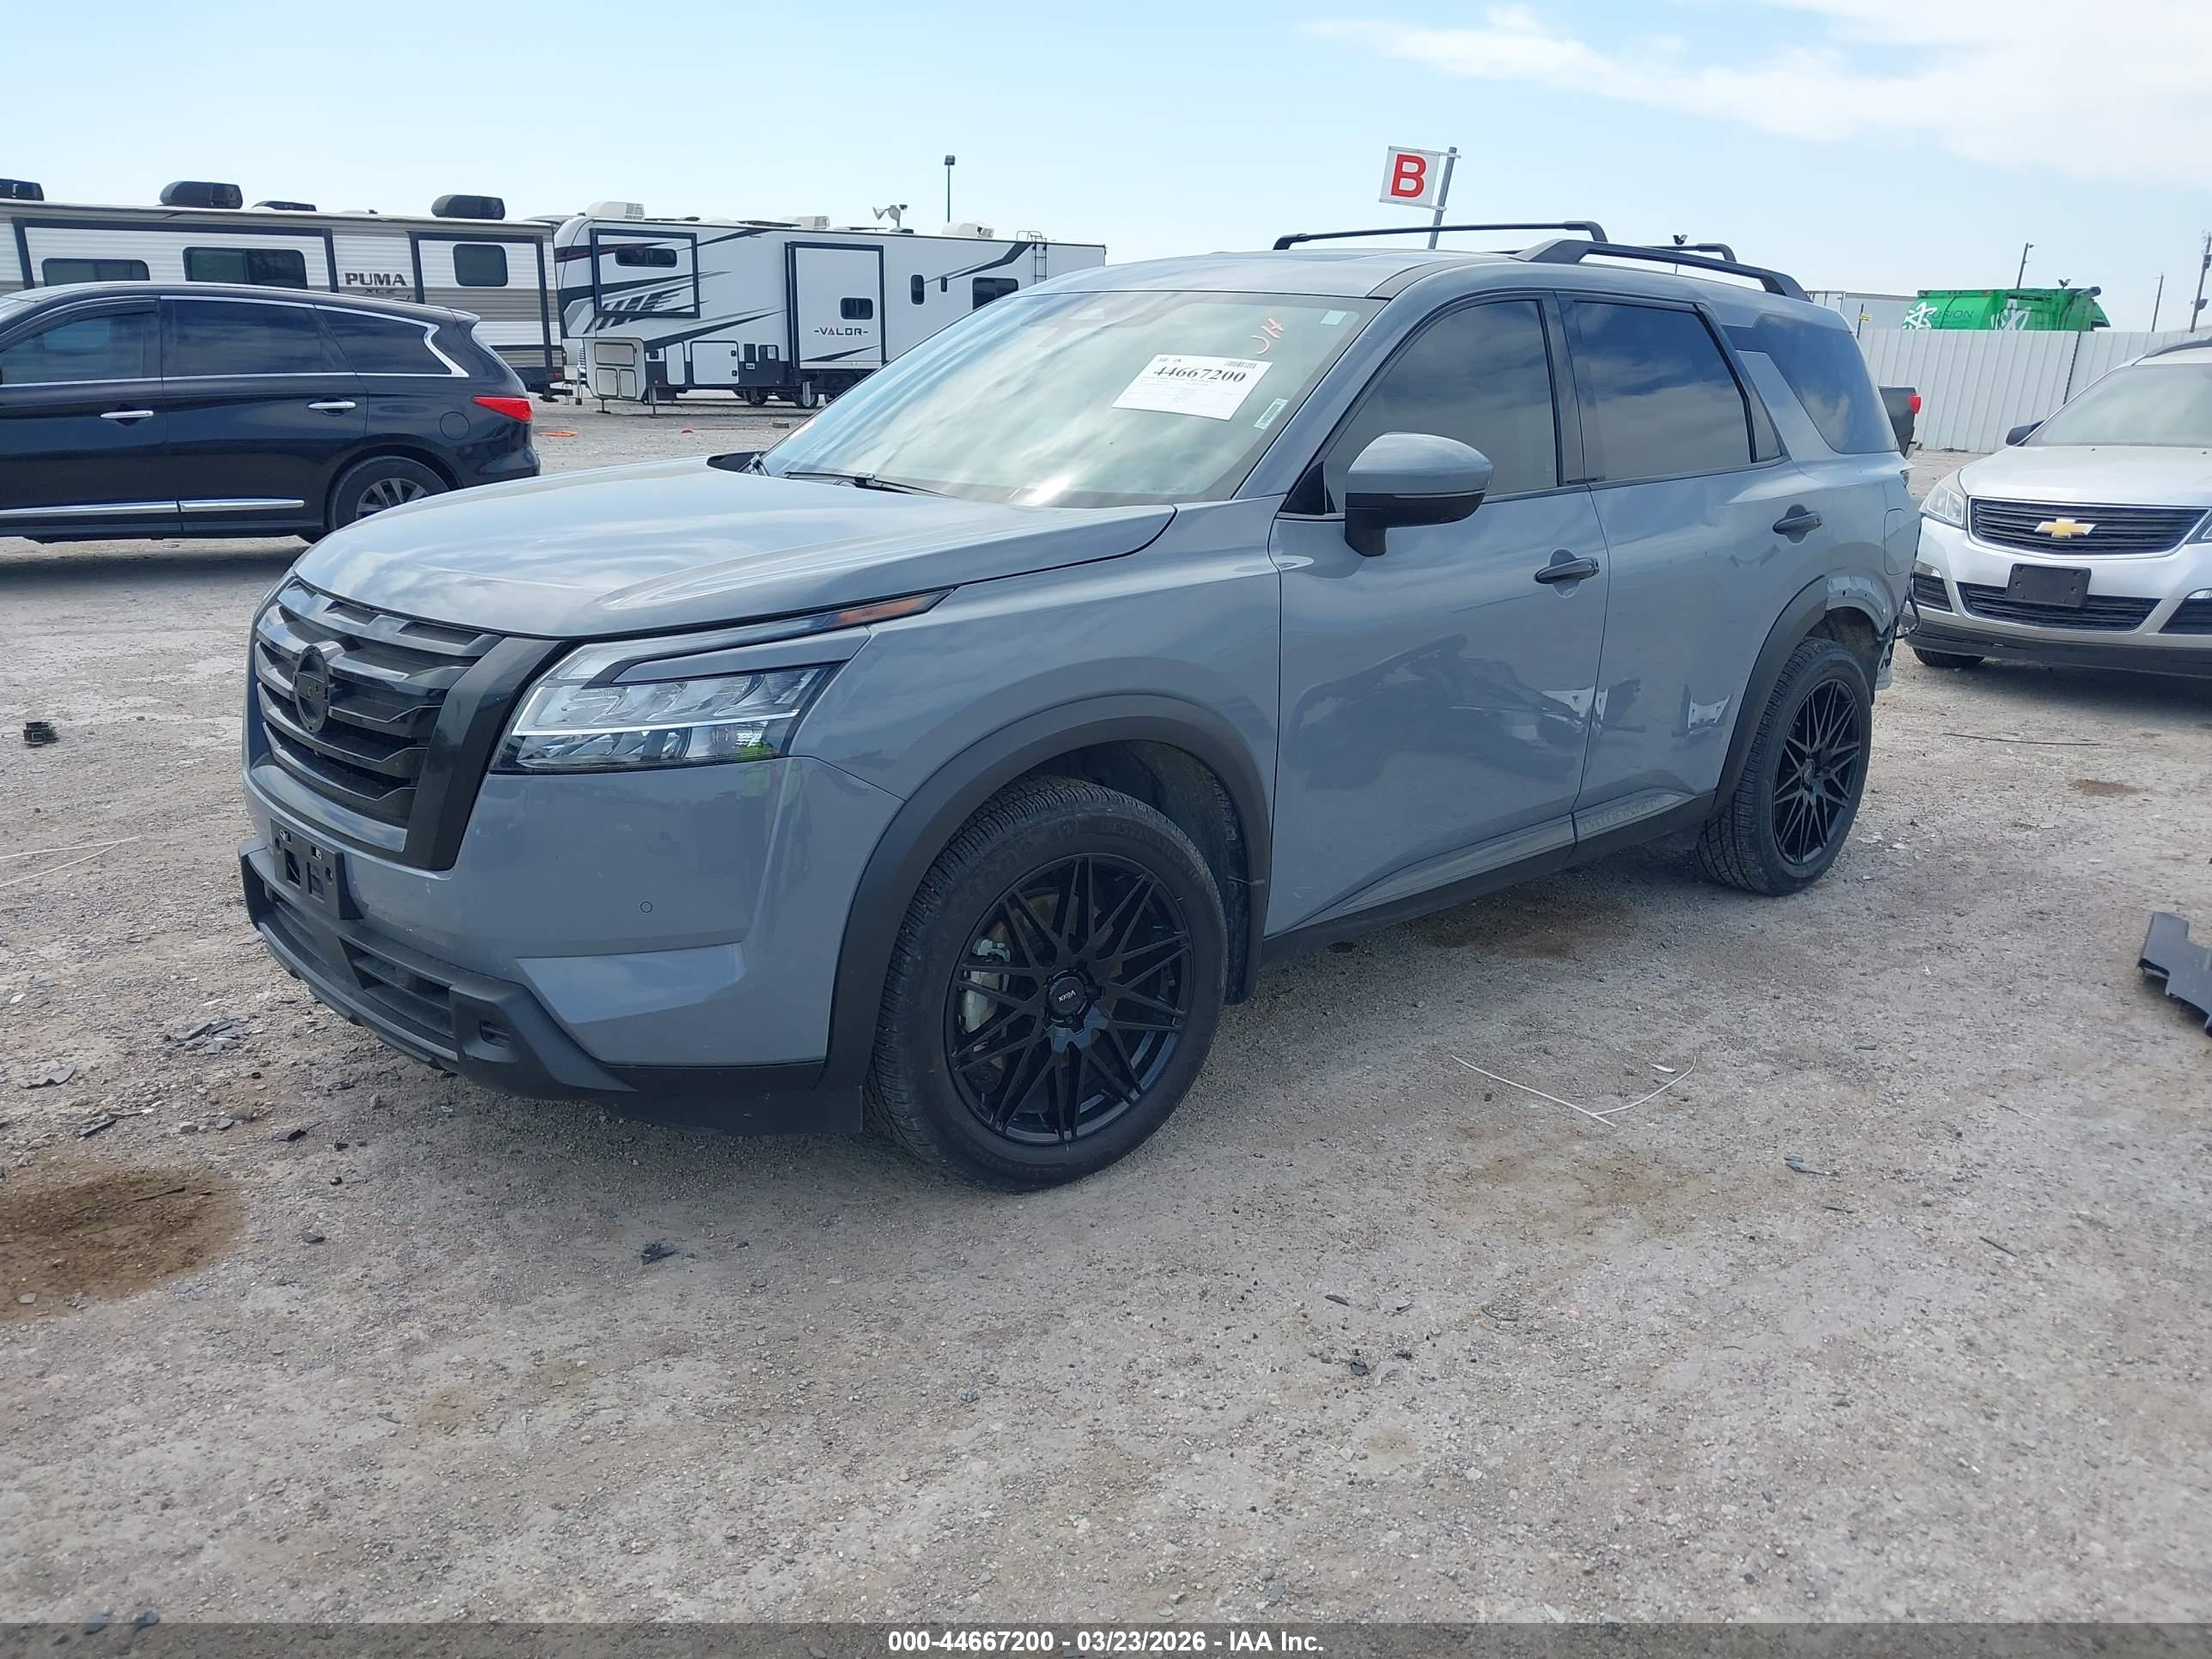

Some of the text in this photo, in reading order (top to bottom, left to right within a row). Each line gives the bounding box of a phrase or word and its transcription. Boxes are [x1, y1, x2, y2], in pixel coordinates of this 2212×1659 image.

[1391, 154, 1426, 198] B
[344, 272, 408, 287] PUMA
[1153, 366, 1247, 383] 44667200
